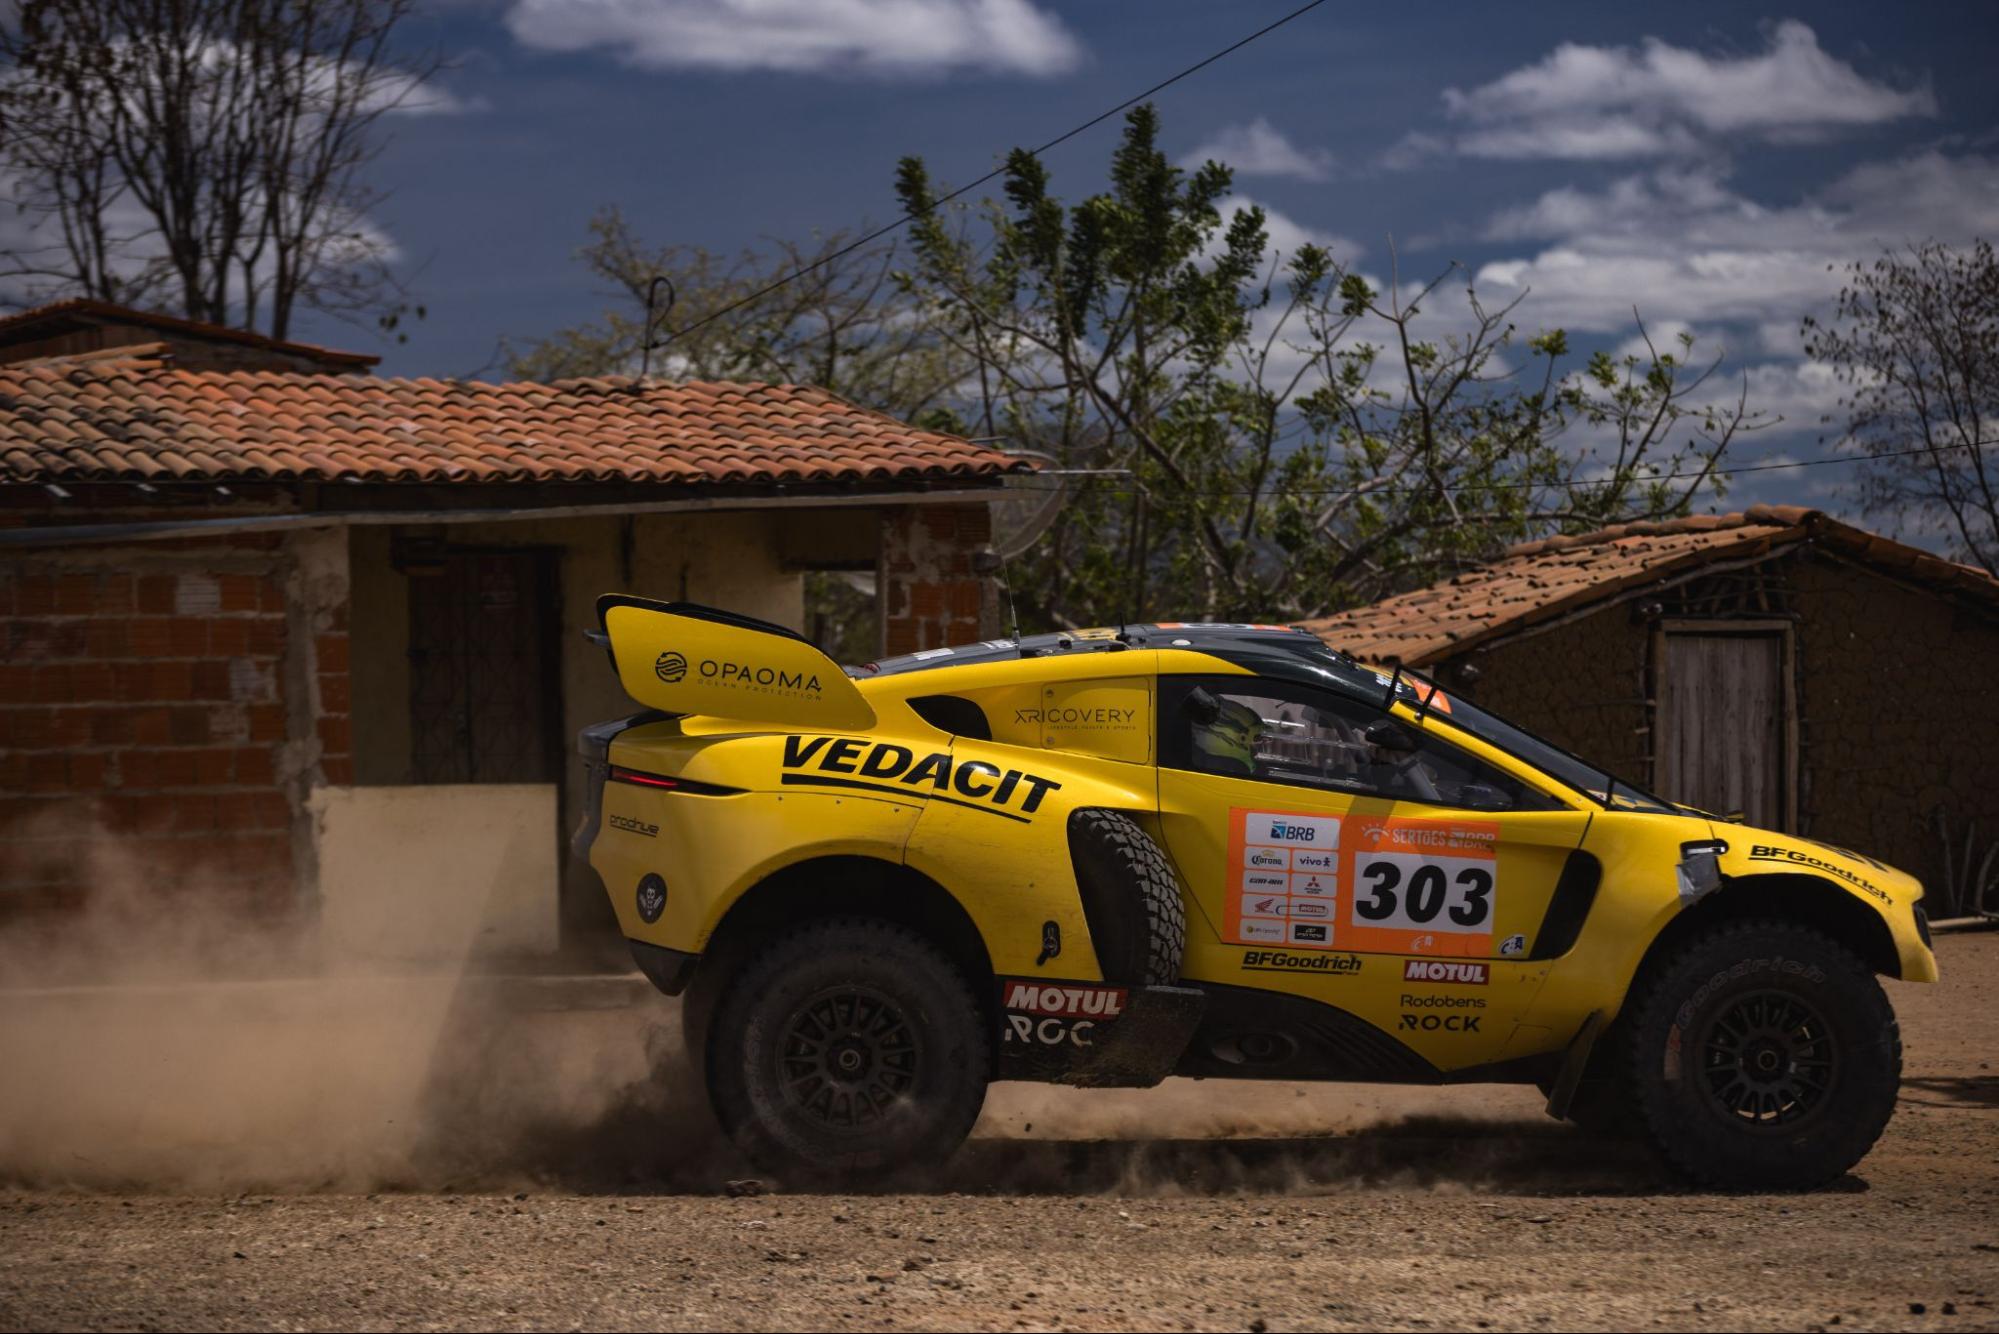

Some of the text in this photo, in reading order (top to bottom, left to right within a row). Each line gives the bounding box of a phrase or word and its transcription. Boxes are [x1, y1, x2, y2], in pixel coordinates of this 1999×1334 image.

[700, 660, 821, 692] OPAOMA
[782, 735, 1062, 814] VEDACIT
[1286, 826, 1315, 841] BRB
[1251, 855, 1283, 867] Corona
[1299, 856, 1322, 866] vivo
[1751, 844, 1895, 906] BFGoodrich
[1355, 861, 1493, 927] 303
[1242, 951, 1362, 971] BFGoodrich
[1405, 962, 1486, 983] MOTUL
[1007, 985, 1121, 1015] MOTUL
[1400, 994, 1487, 1008] Rodobens
[1398, 1014, 1482, 1033] ROCK
[1664, 955, 1827, 1080] FGoodrich
